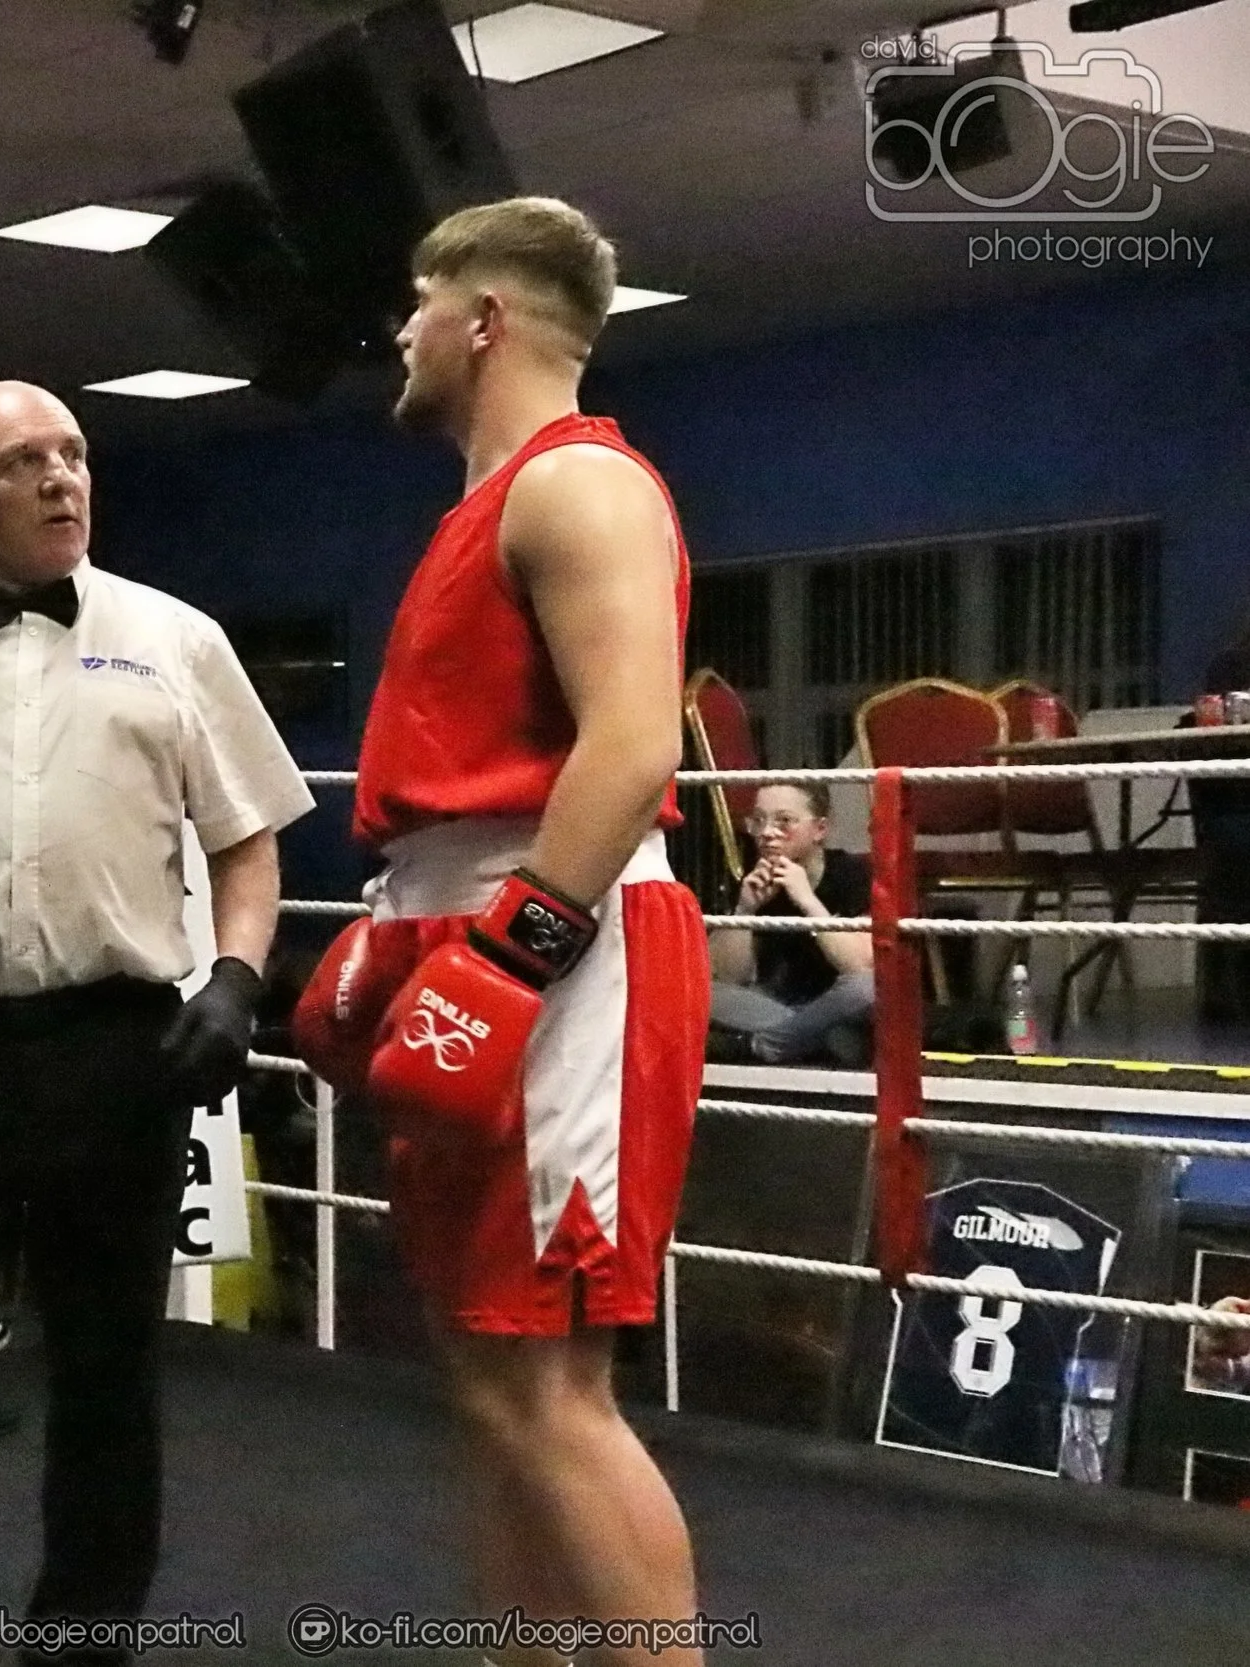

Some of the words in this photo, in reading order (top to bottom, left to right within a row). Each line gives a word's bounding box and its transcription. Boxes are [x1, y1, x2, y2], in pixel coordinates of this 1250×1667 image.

[335, 960, 355, 1020] STING
[417, 986, 491, 1040] STING
[950, 1265, 1023, 1398] 8
